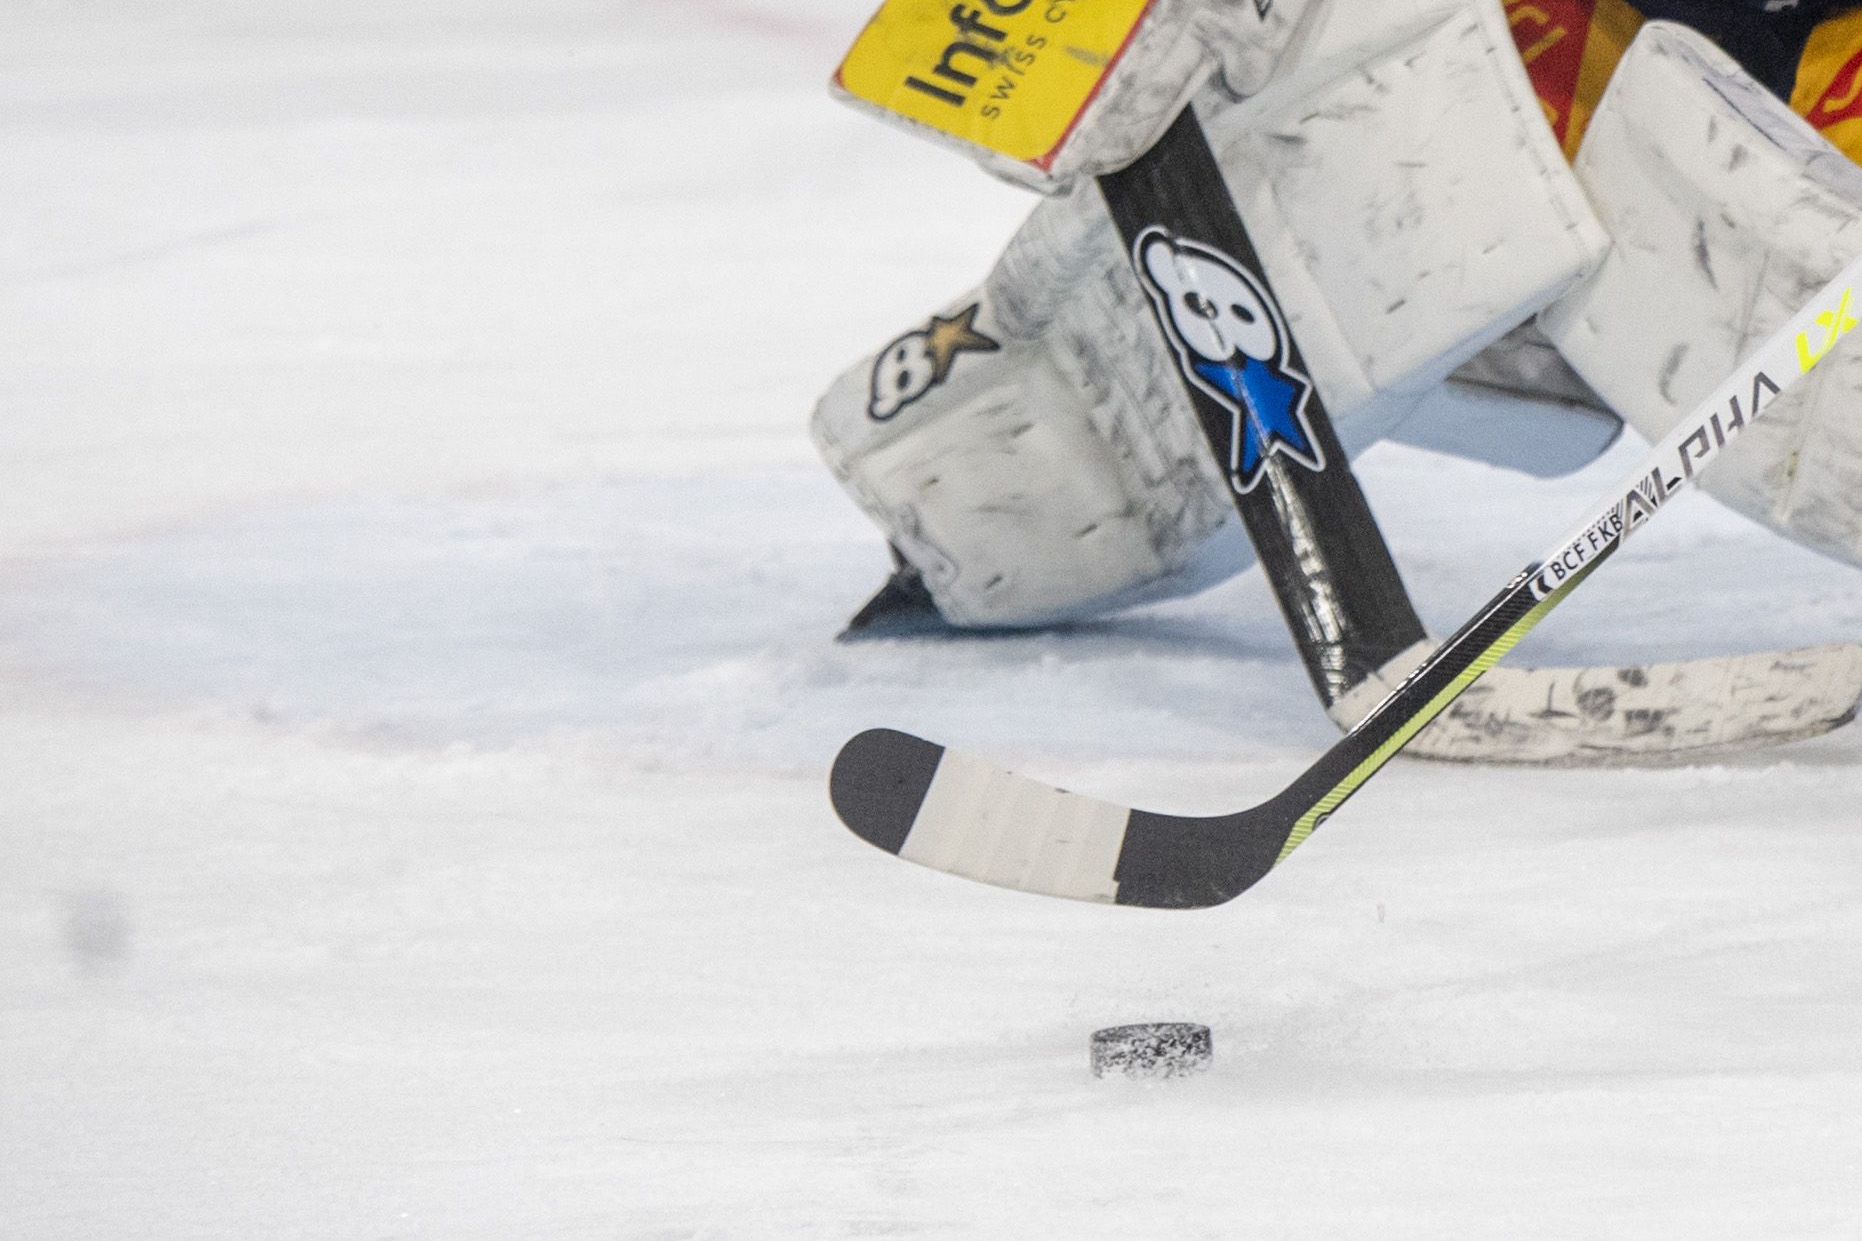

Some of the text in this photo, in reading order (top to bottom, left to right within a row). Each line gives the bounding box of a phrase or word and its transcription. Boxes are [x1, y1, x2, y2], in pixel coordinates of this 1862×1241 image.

[980, 34, 1047, 121] SWISS
[1795, 286, 1858, 374] LX
[1551, 371, 1782, 582] BCF FKB ALPHA
